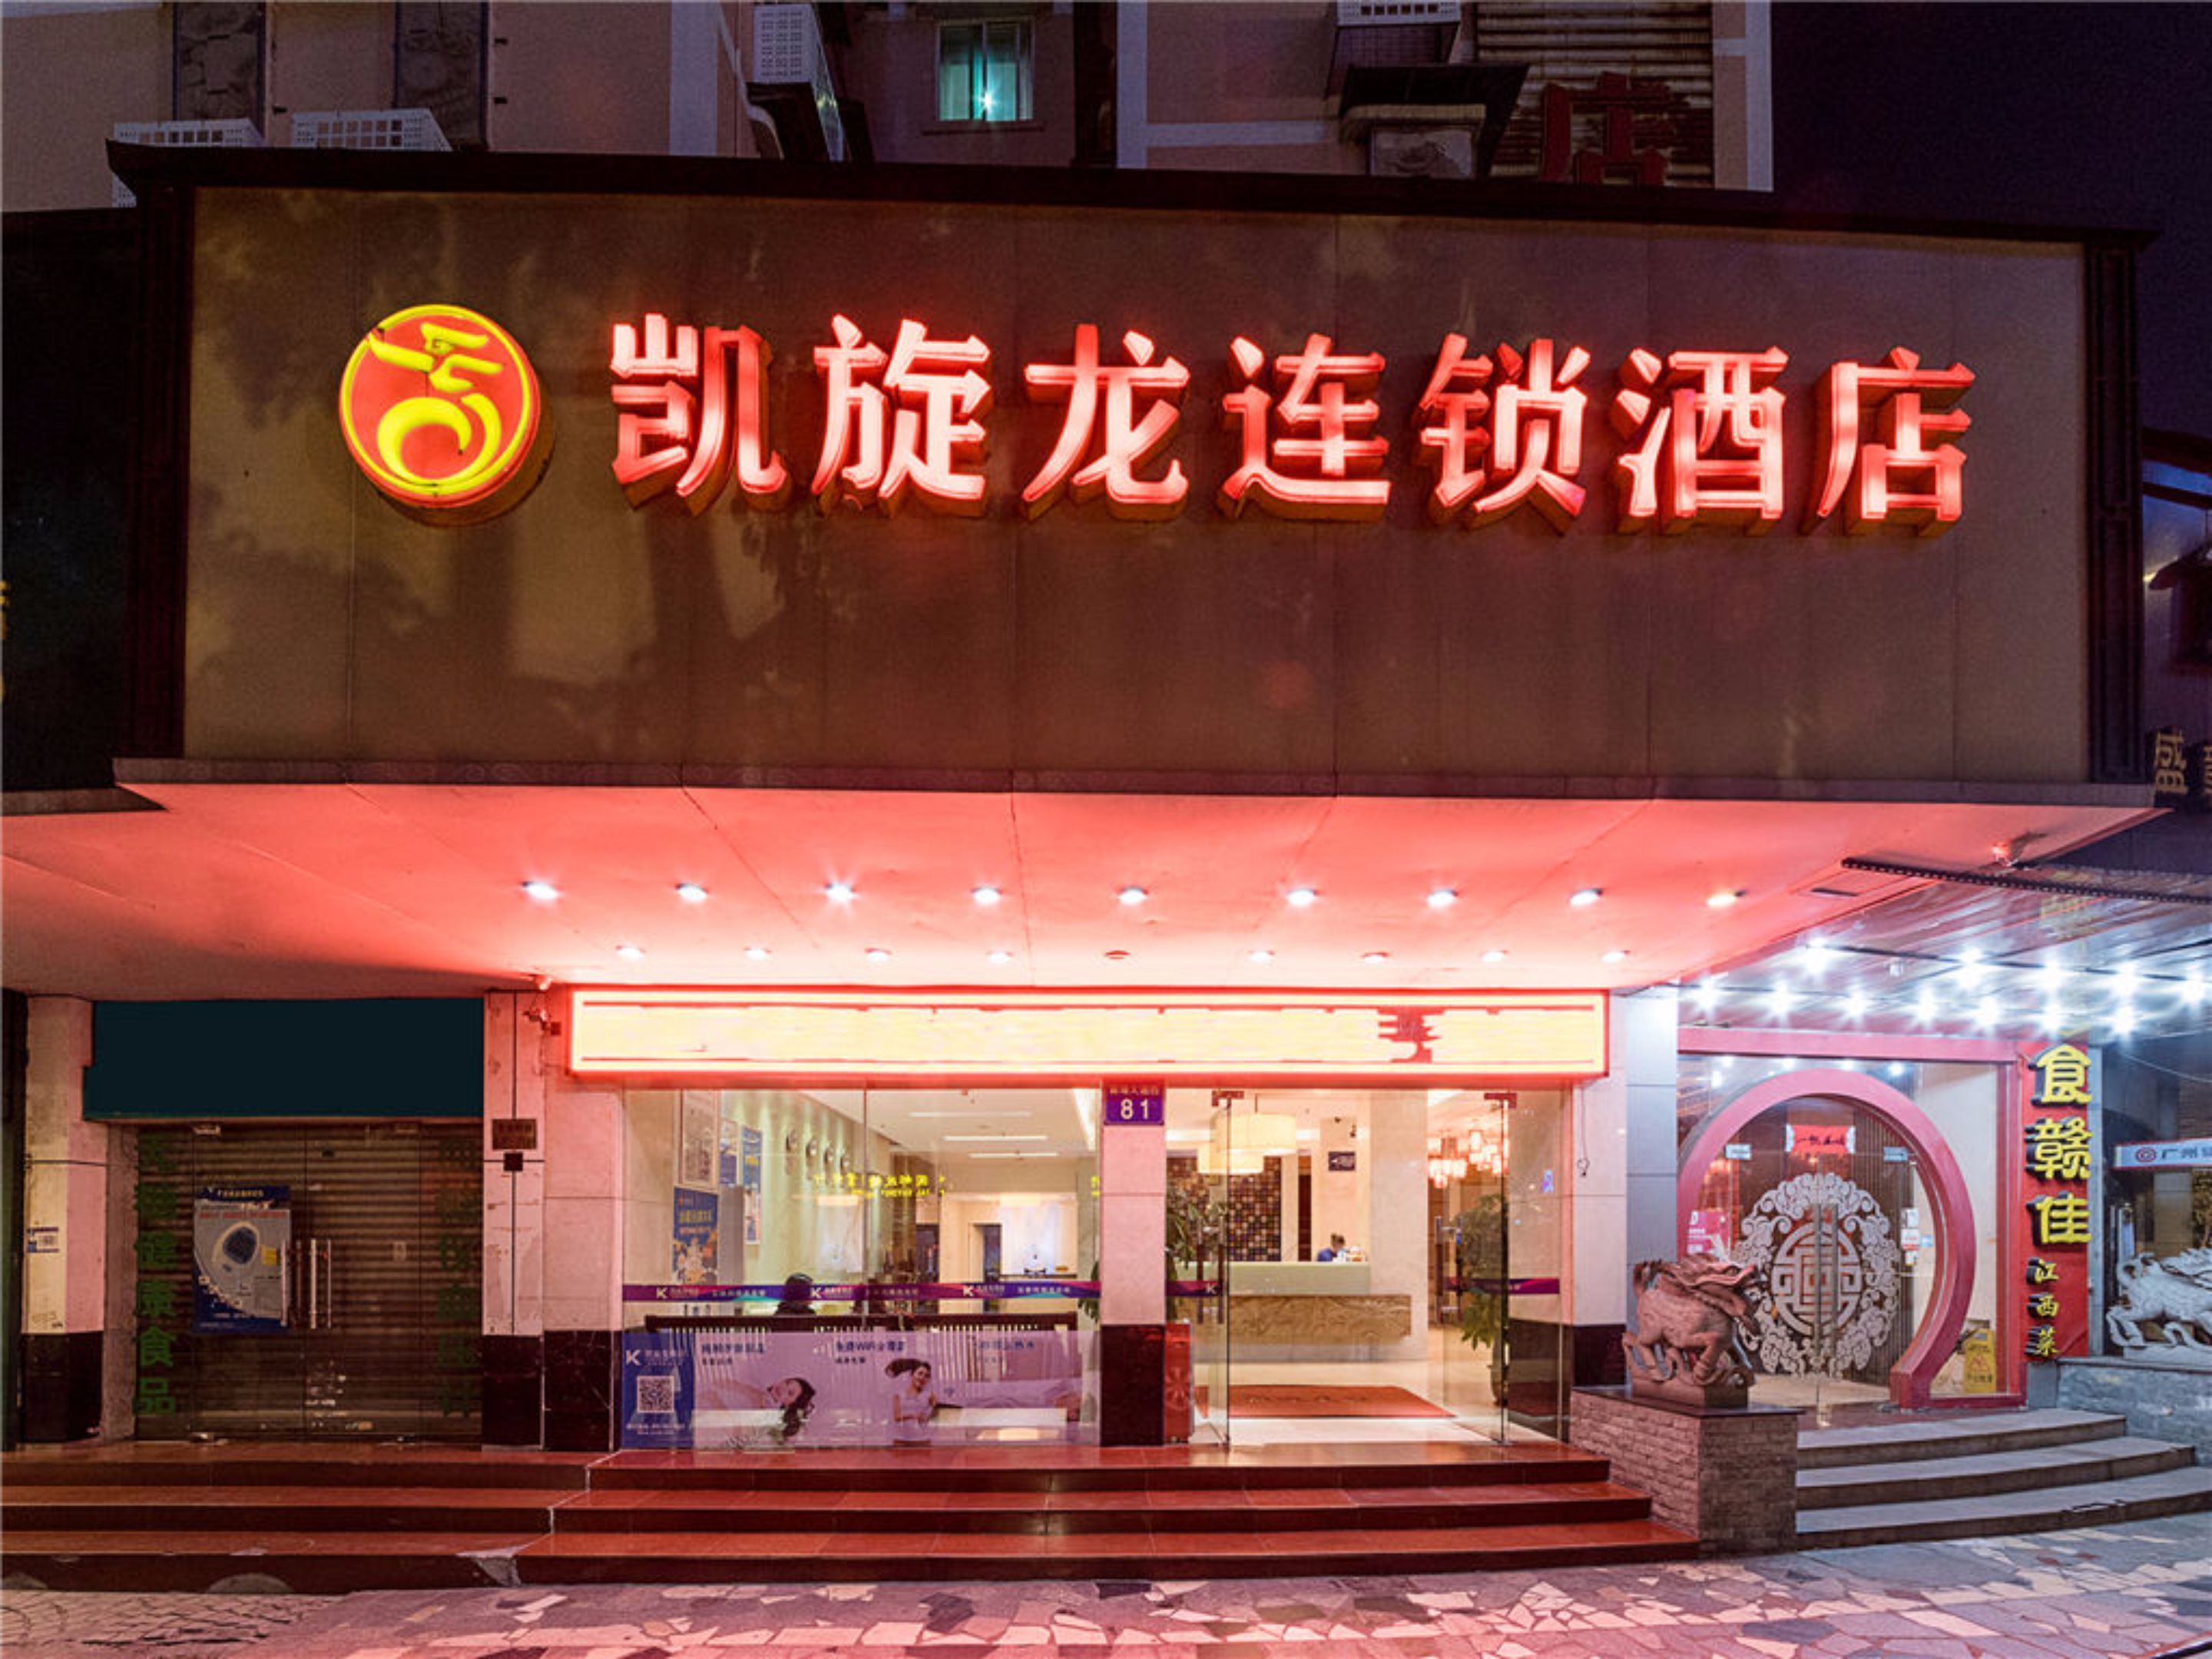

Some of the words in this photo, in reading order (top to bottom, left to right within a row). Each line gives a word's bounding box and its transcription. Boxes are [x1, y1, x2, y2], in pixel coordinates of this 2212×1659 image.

[610, 312, 1974, 526] 凯旋龙连锁酒店
[1120, 1098, 1149, 1120] 81
[2031, 1042, 2093, 1246] 食赣佳
[2032, 1257, 2060, 1357] 江西菜
